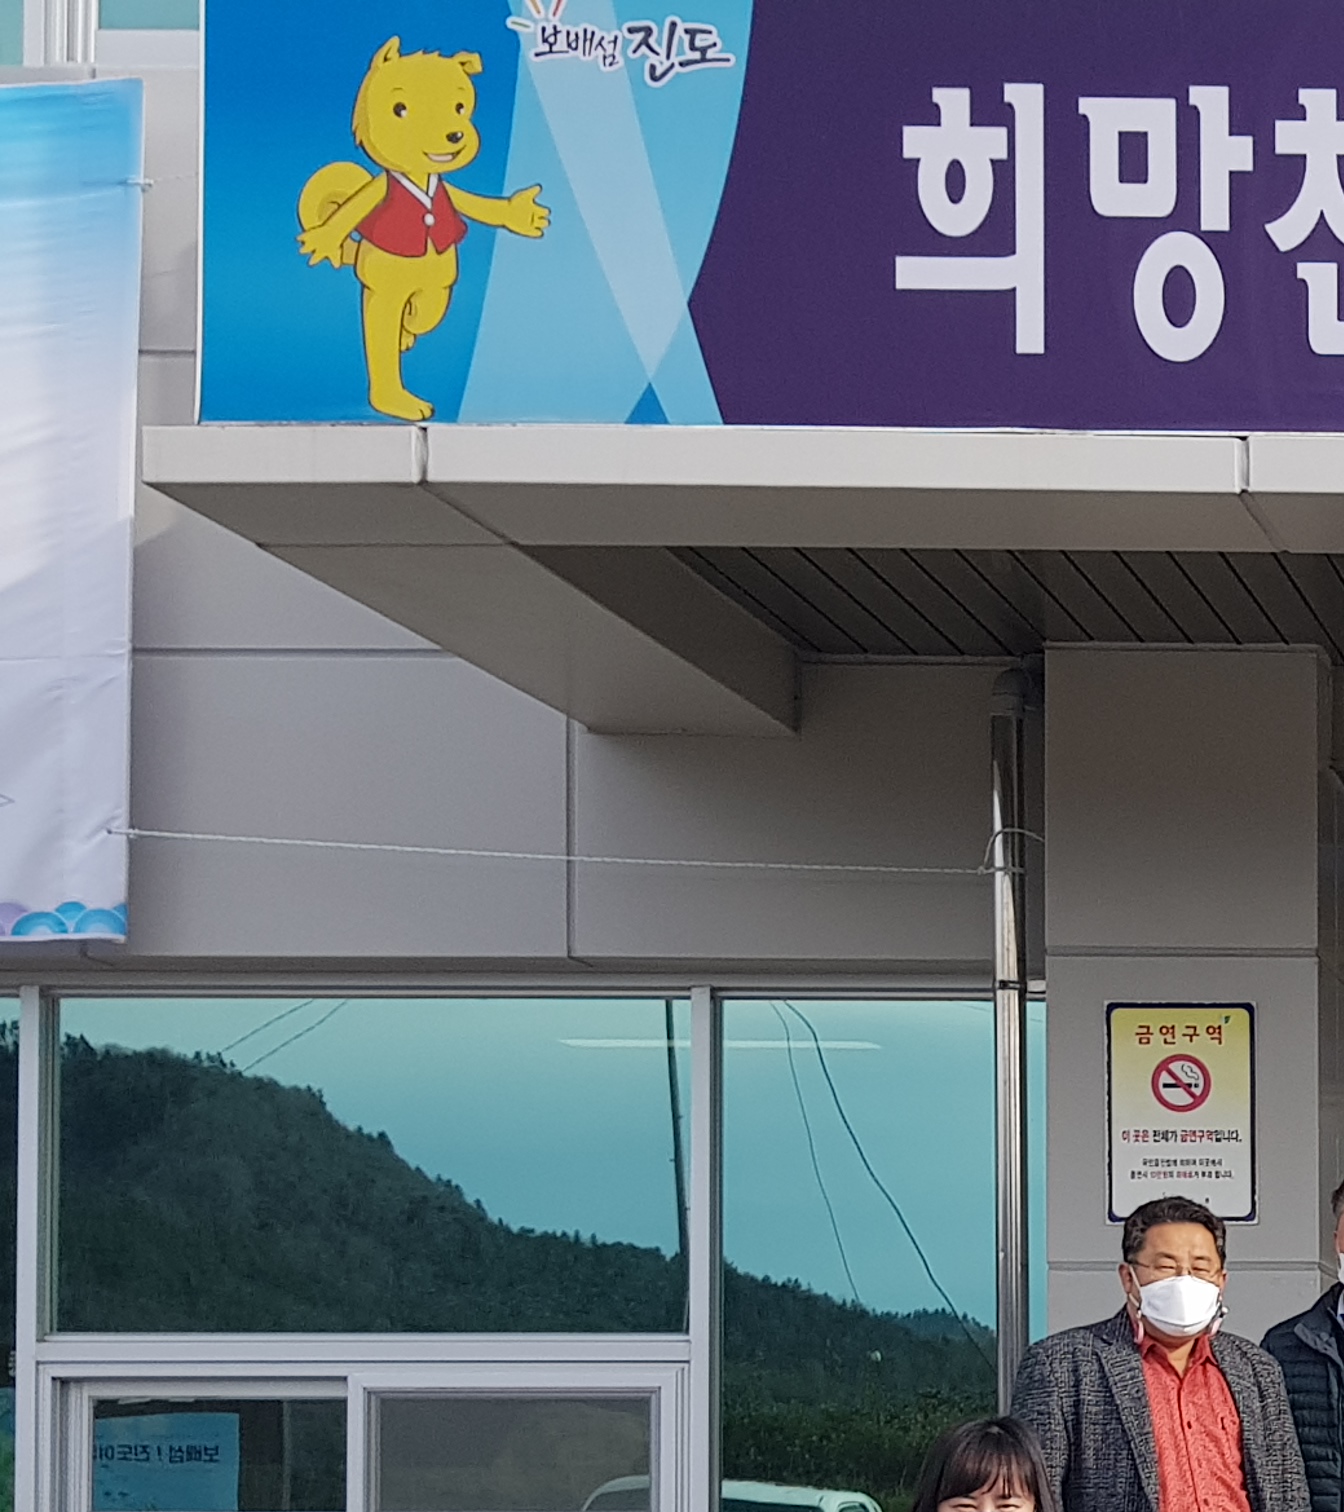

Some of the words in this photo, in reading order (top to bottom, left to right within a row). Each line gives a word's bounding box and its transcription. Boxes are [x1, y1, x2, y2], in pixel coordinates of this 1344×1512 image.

[534, 24, 619, 67] 보배섬
[626, 19, 731, 82] 진도
[1152, 1129, 1178, 1143] 전체가
